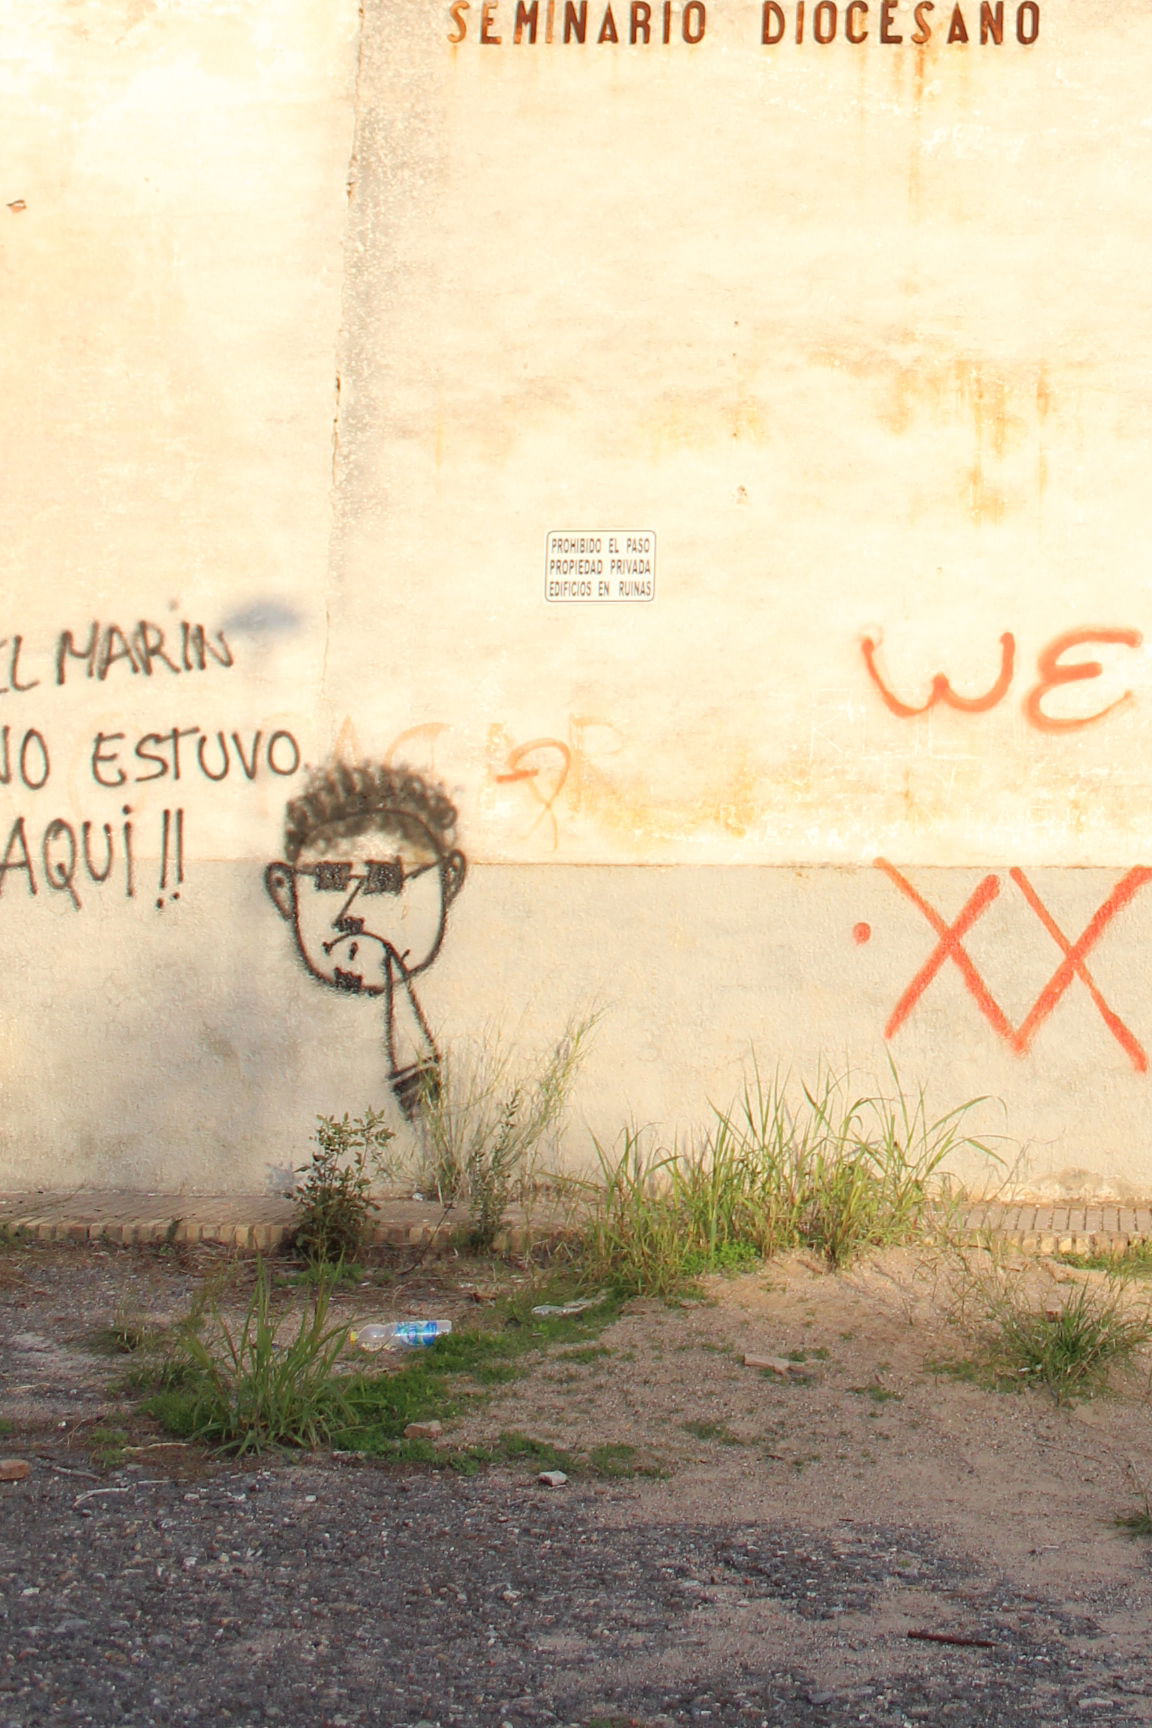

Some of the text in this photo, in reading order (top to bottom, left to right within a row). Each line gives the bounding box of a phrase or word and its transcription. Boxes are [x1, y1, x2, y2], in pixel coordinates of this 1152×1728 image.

[448, 0, 1040, 47] SEMINARIO DIOCESANO
[551, 537, 651, 554] PROHIBIDO EL PASO
[549, 558, 651, 575] PROPIEDAD PRIVADA
[548, 580, 652, 597] EDIFICIOS EN RUINAS
[858, 626, 1144, 734] WE
[91, 725, 301, 788] ESTUVO
